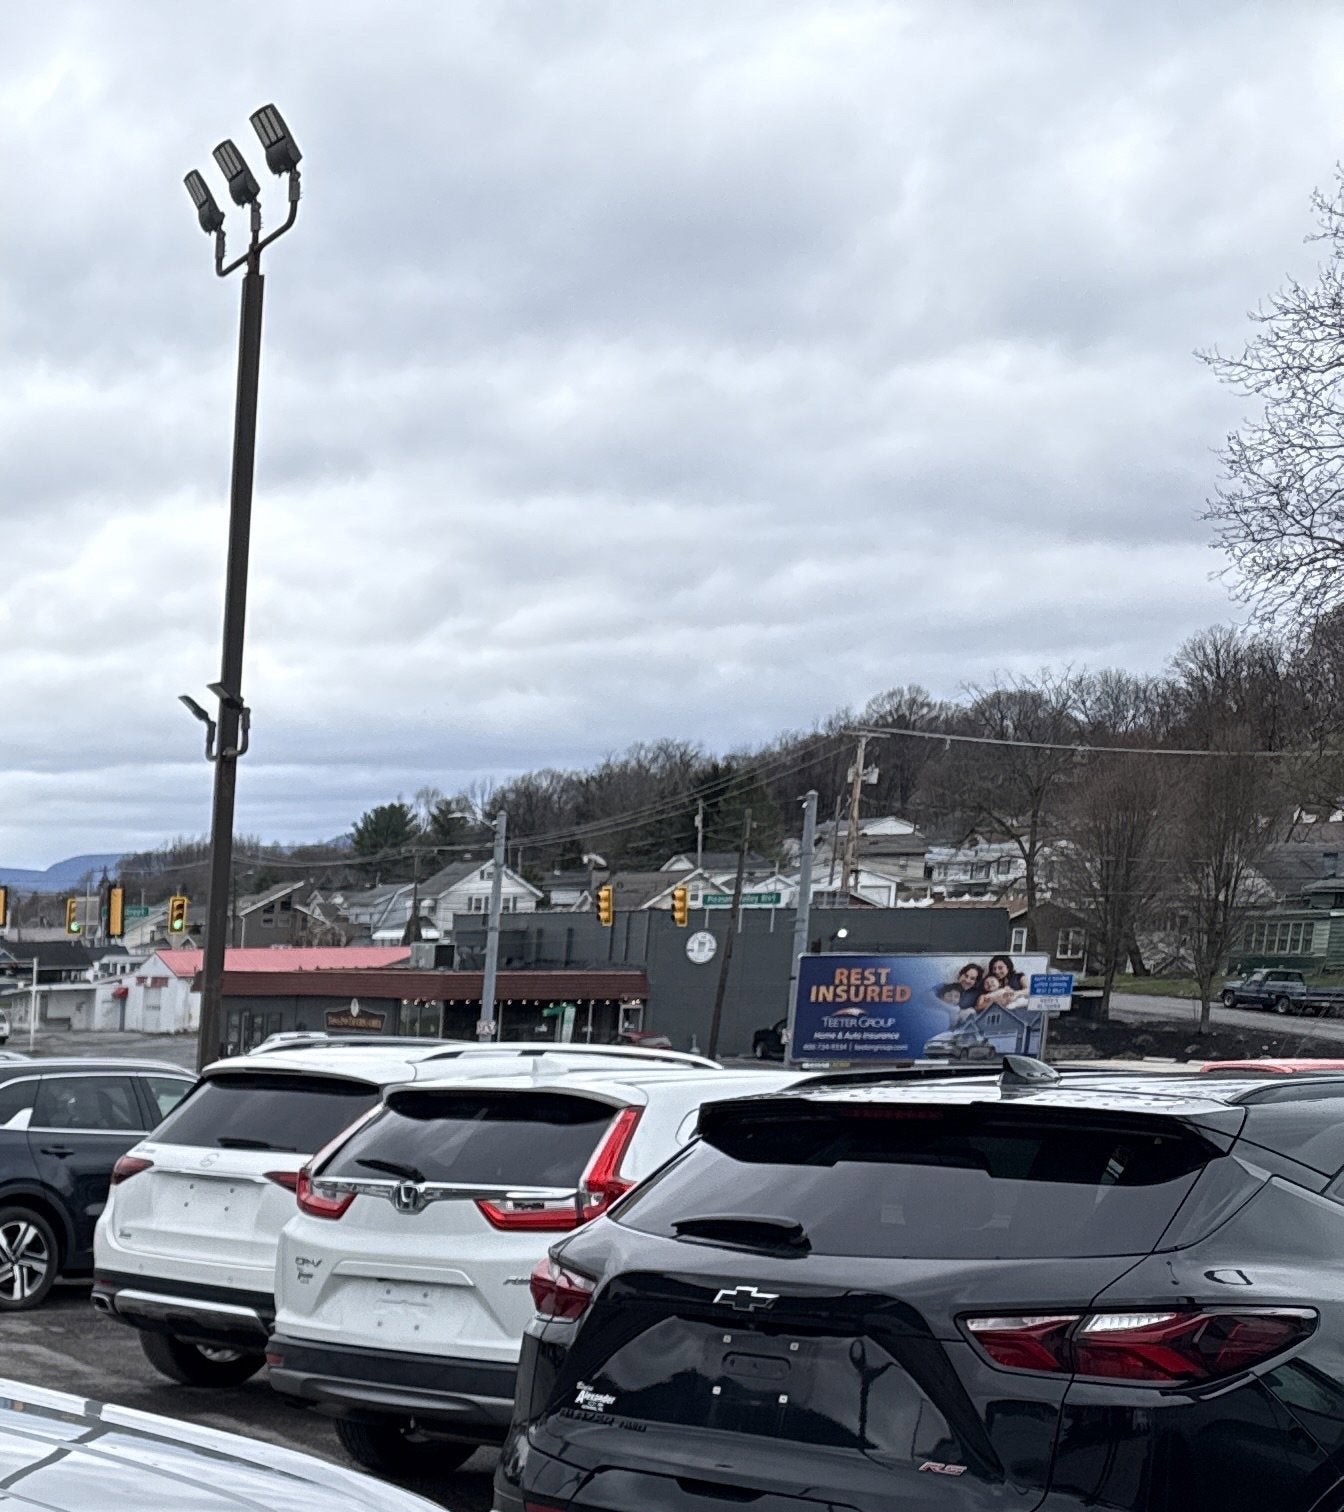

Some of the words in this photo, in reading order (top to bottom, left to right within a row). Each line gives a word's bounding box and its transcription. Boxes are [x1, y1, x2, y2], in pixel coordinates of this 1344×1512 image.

[834, 967, 891, 985] REST
[809, 984, 912, 1003] INSURED
[918, 1461, 968, 1476] RS
